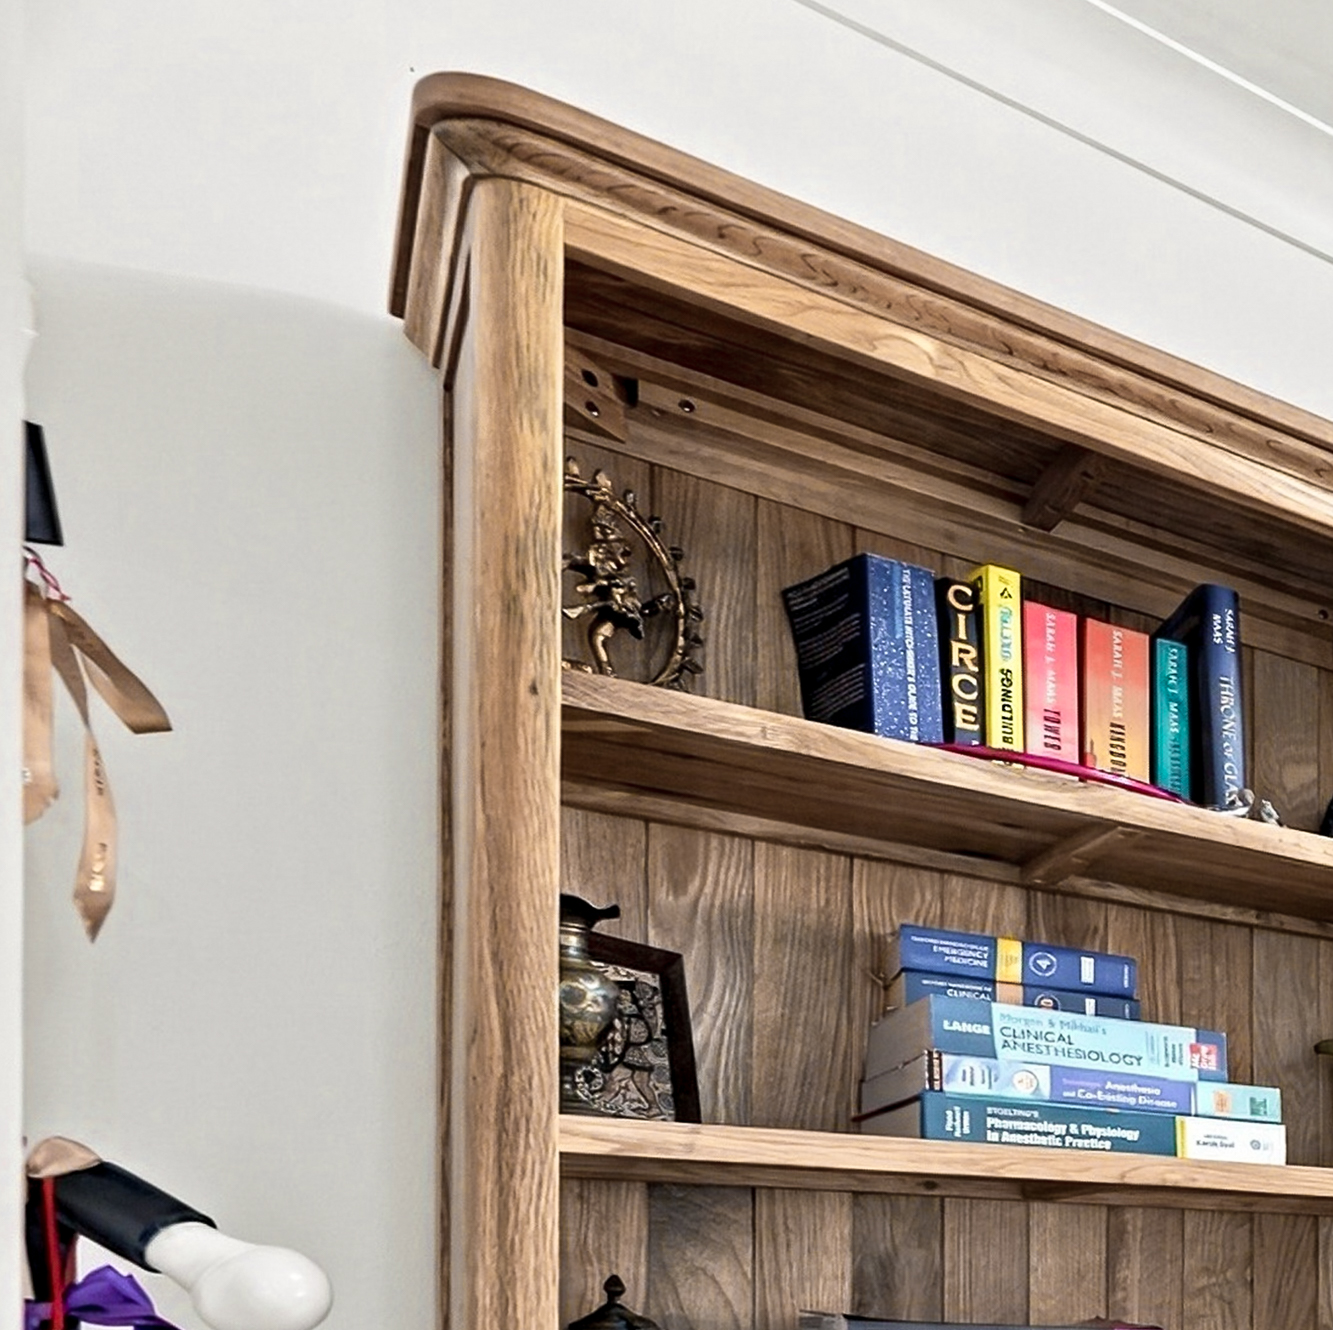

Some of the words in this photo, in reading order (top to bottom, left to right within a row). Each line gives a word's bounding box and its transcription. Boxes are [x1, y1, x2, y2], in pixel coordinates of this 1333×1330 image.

[1212, 613, 1224, 645] MAAS
[1225, 608, 1236, 644] SARAH
[947, 584, 980, 732] CIRCE
[1112, 630, 1123, 668] SARAH
[1167, 646, 1179, 685] SARAH
[1000, 668, 1014, 745] BUILDINGS
[1112, 685, 1123, 719] MAAS
[1219, 676, 1237, 741] THRONE
[1043, 708, 1062, 751] TOWER
[1168, 701, 1180, 734] MAAS
[933, 945, 988, 959] EMERGENCY
[944, 956, 988, 968] MEDICINE
[947, 988, 992, 1001] CLINICAL
[943, 1019, 991, 1036] LANGE
[1000, 1026, 1075, 1046] CLINICAL
[1001, 1038, 1143, 1067] ANESTHESIOLOGY
[1105, 1081, 1161, 1095] Anesthesia
[1138, 1096, 1177, 1108] Disease
[986, 1117, 1067, 1135] Pharmacology
[1069, 1123, 1079, 1134] &
[1081, 1124, 1140, 1141] Physiology
[1001, 1131, 1062, 1147] Anesthetic
[1064, 1136, 1112, 1150] Practice
